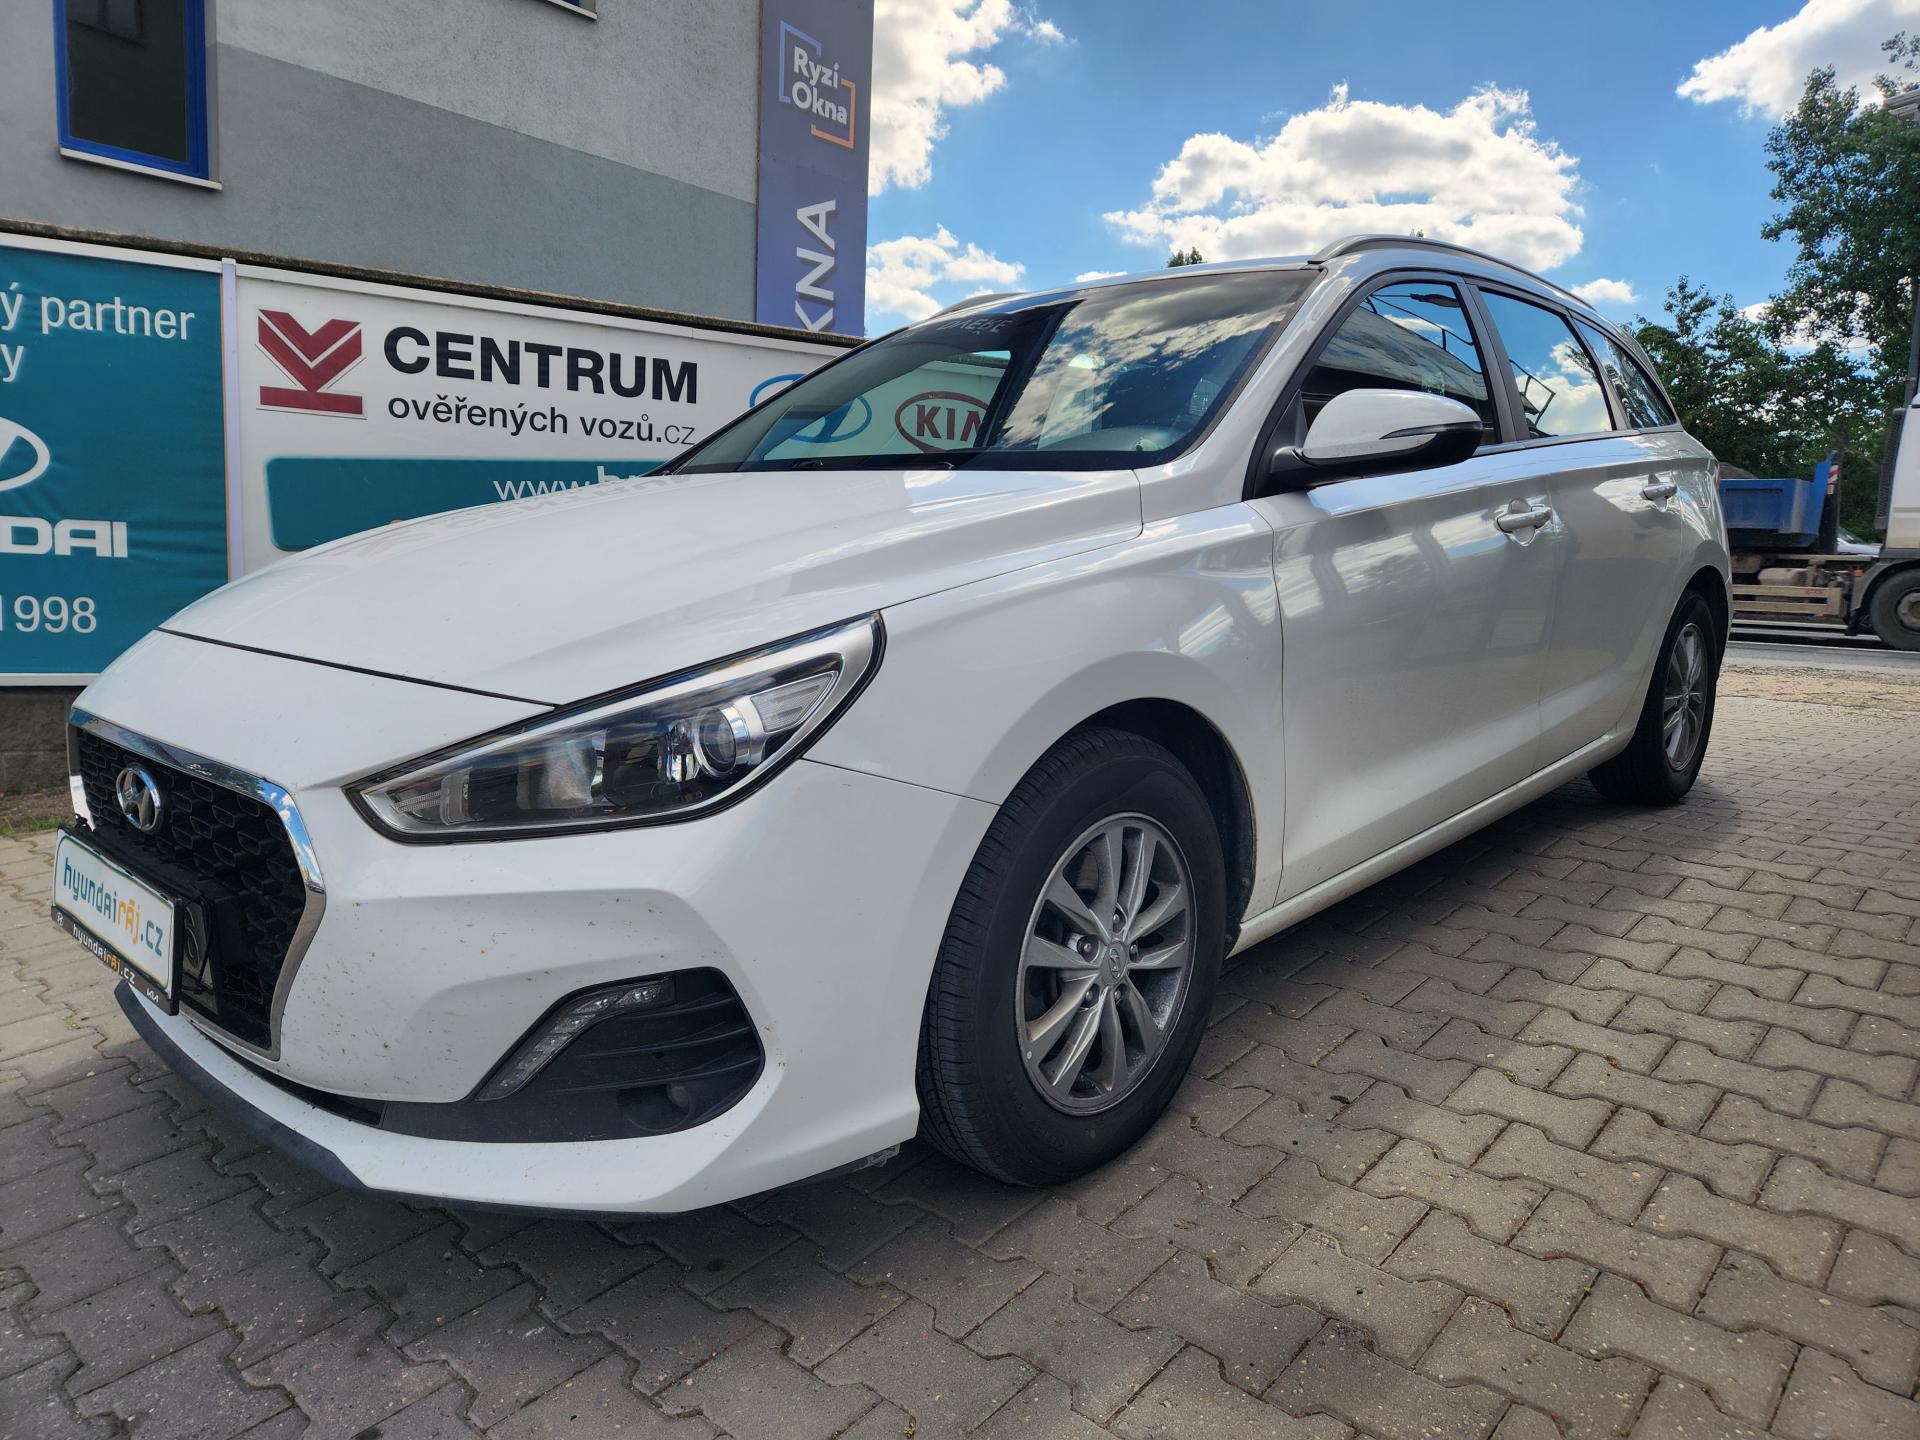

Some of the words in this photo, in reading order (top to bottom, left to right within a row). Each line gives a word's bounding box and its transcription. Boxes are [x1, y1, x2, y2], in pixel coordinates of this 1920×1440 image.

[793, 46, 839, 89] Ryzi
[791, 81, 848, 125] Okna
[41, 296, 195, 341] partner
[383, 325, 698, 405] CENTRUM
[387, 394, 568, 436] ověřených
[579, 413, 696, 446] vozů.cz
